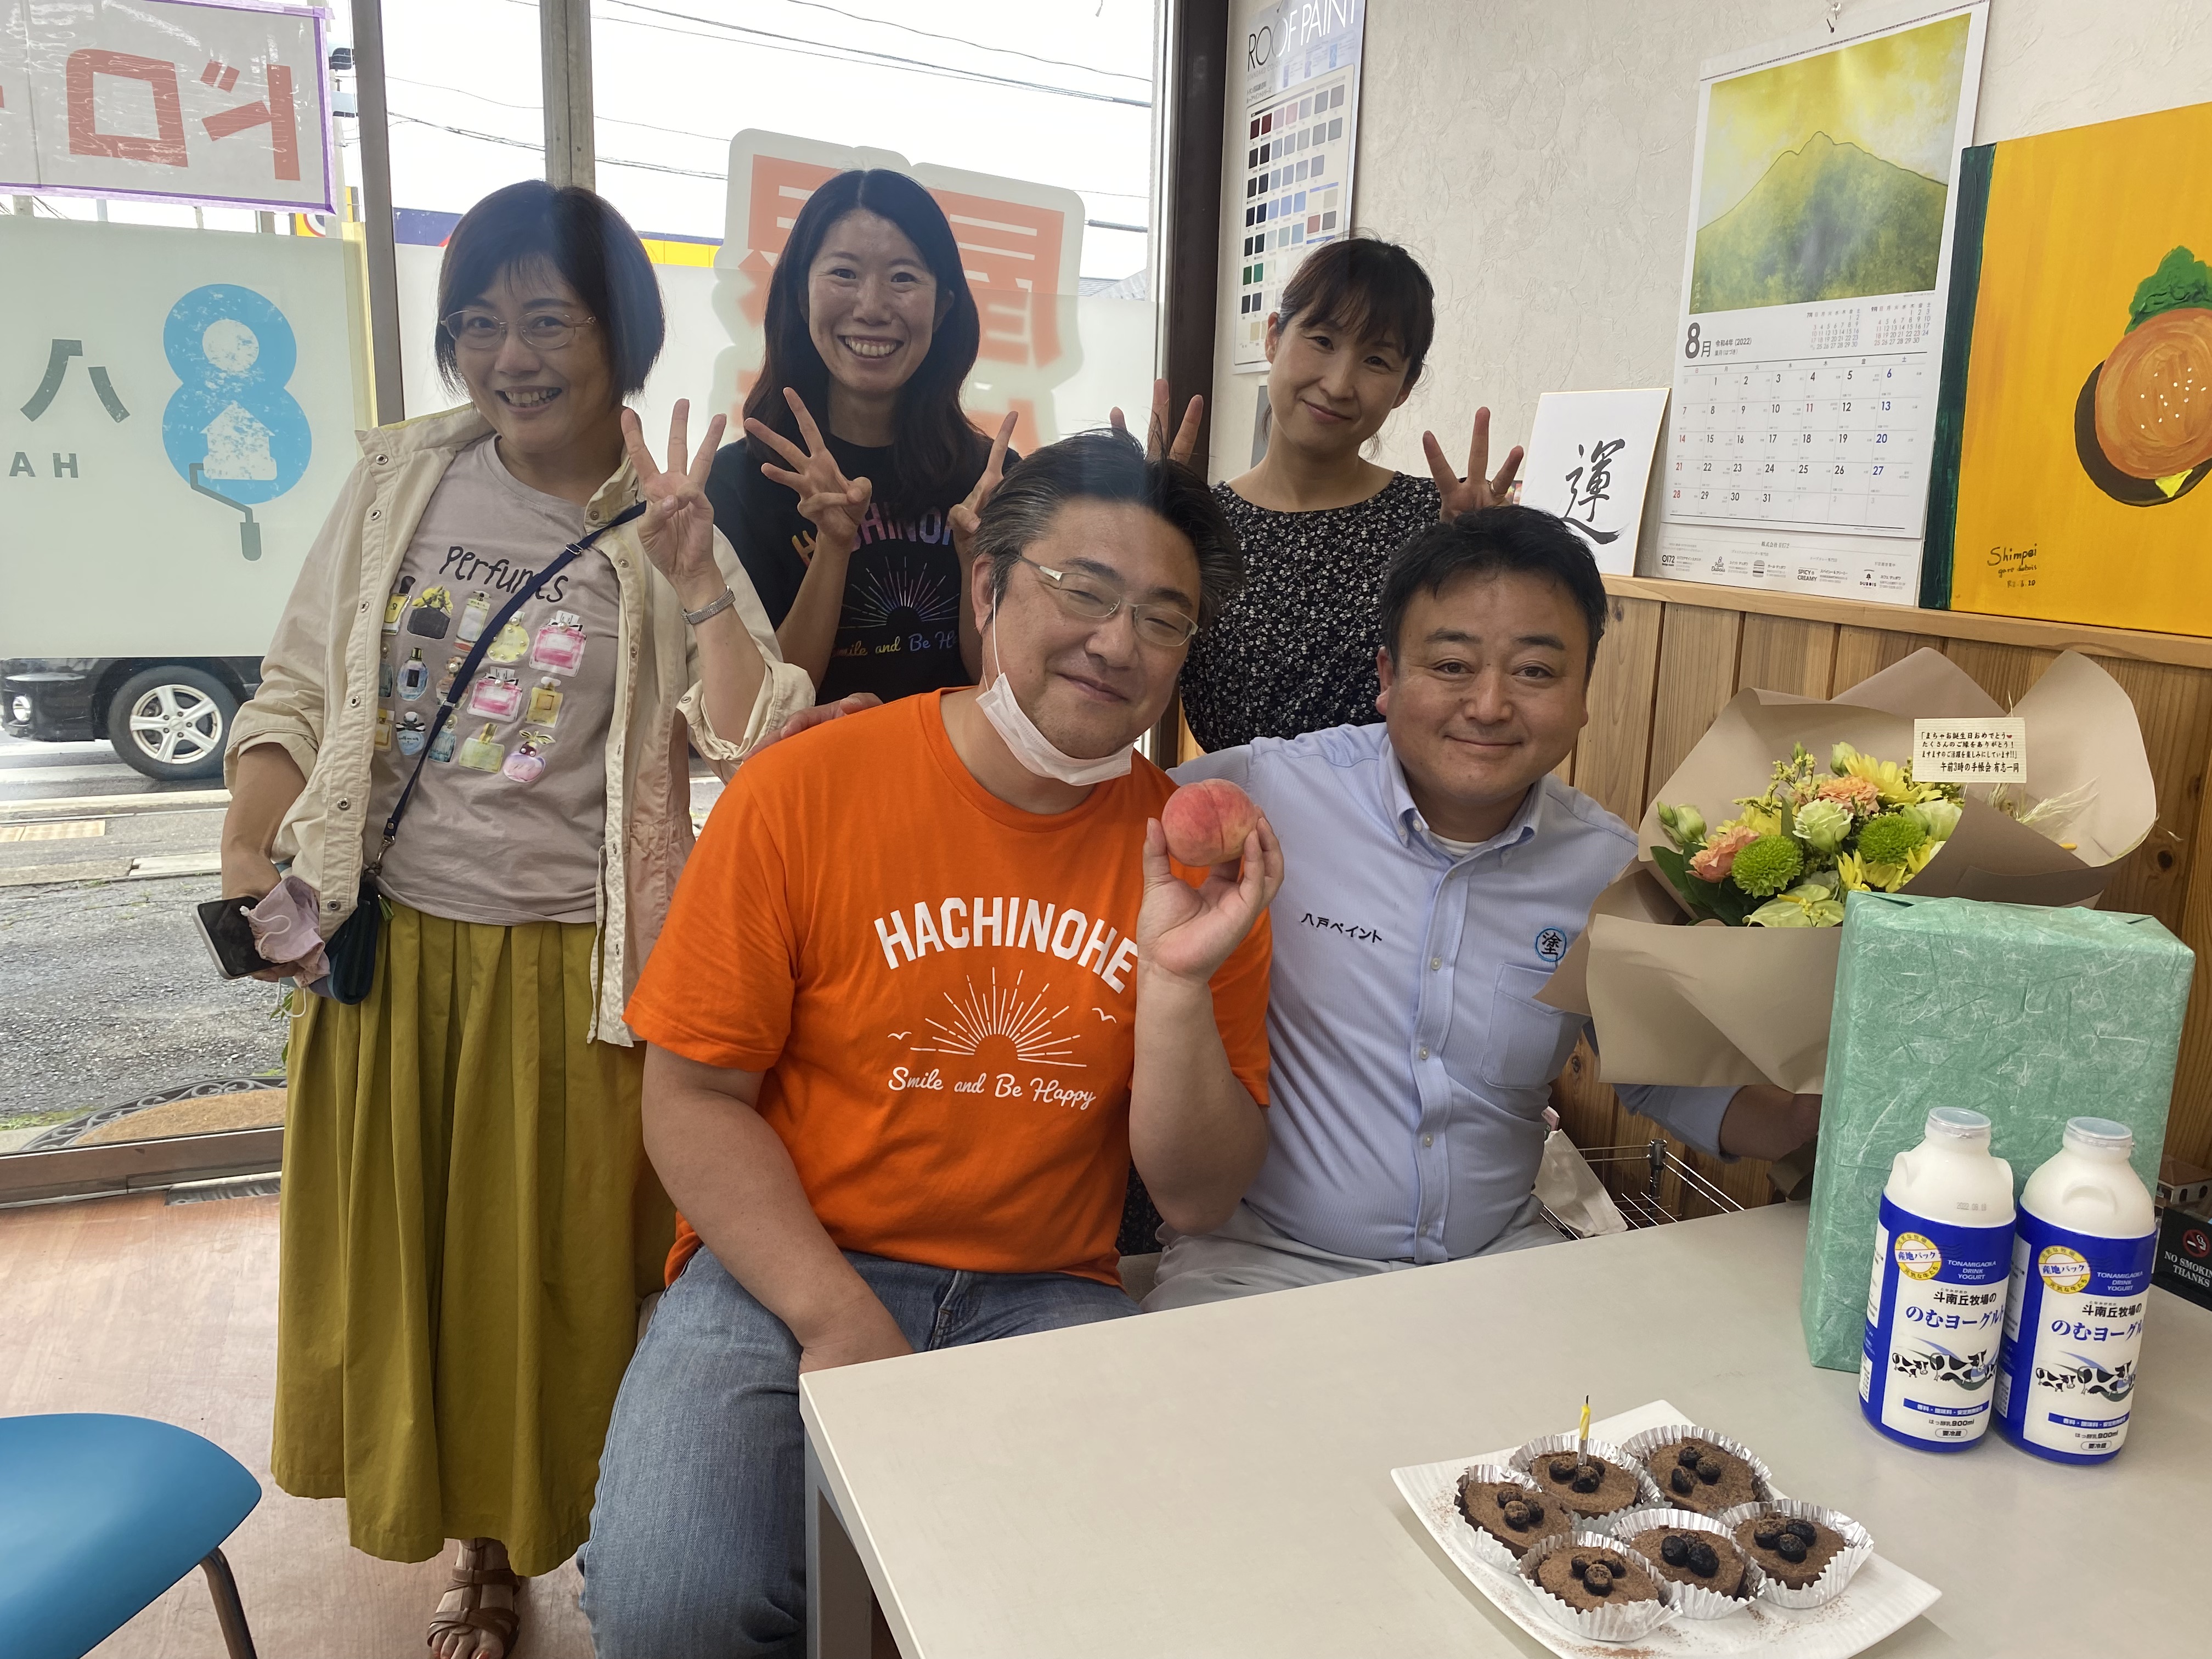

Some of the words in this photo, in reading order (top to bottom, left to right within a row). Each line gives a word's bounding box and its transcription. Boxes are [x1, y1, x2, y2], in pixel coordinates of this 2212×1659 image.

[1247, 9, 1297, 72] ROOF
[1685, 322, 1712, 359] 8月
[1715, 339, 1734, 347] 令和4年
[1735, 337, 1752, 346] (2022)
[1744, 376, 1748, 385] 2
[1776, 374, 1780, 382] 3
[1810, 372, 1815, 381] 4
[1847, 370, 1853, 380] 5
[1887, 369, 1892, 378] 6
[1711, 406, 1714, 414] 8
[1772, 404, 1780, 413] 10
[1807, 403, 1813, 412] 11
[1843, 402, 1851, 411] 12
[1882, 402, 1891, 410] 13
[1680, 435, 1685, 443] 14
[1707, 435, 1714, 443] 15
[1737, 435, 1743, 443] 16
[1770, 435, 1777, 443] 17
[1803, 434, 1811, 443] 18
[1839, 434, 1847, 443] 19
[1876, 434, 1887, 443] 20
[1676, 462, 1682, 471] 21
[1703, 463, 1711, 471] 22
[1734, 464, 1741, 472] 23
[1765, 464, 1774, 473] 24
[1798, 465, 1808, 473] 25
[1835, 465, 1844, 474] 26
[1872, 466, 1883, 475] 27
[1673, 490, 1680, 498] 28
[1701, 491, 1708, 499] 29
[1731, 493, 1739, 501] 30
[1763, 494, 1770, 502] 31
[1662, 555, 1675, 563] 0172
[832, 641, 868, 657] mile
[875, 636, 901, 654] and
[909, 633, 931, 652] Be
[1994, 762, 2019, 773] 有志一同
[1300, 912, 1383, 944] 八戸ペイント
[874, 896, 1138, 994] HACHINOHE
[1541, 932, 1563, 956] 塗
[888, 1066, 944, 1091] Smile
[954, 1073, 985, 1093] and
[995, 1073, 1023, 1098] Be
[1030, 1077, 1096, 1110] Happy
[1899, 1251, 1936, 1260] 産地パック
[2164, 1251, 2178, 1263] NO
[2042, 1264, 2085, 1274] 産地パック
[2172, 1264, 2210, 1288] THANKS
[1933, 1291, 1997, 1306] 斗南丘牧場の
[2082, 1303, 2142, 1318] 斗南丘牧場の
[2051, 1319, 2143, 1342] のむヨーグル
